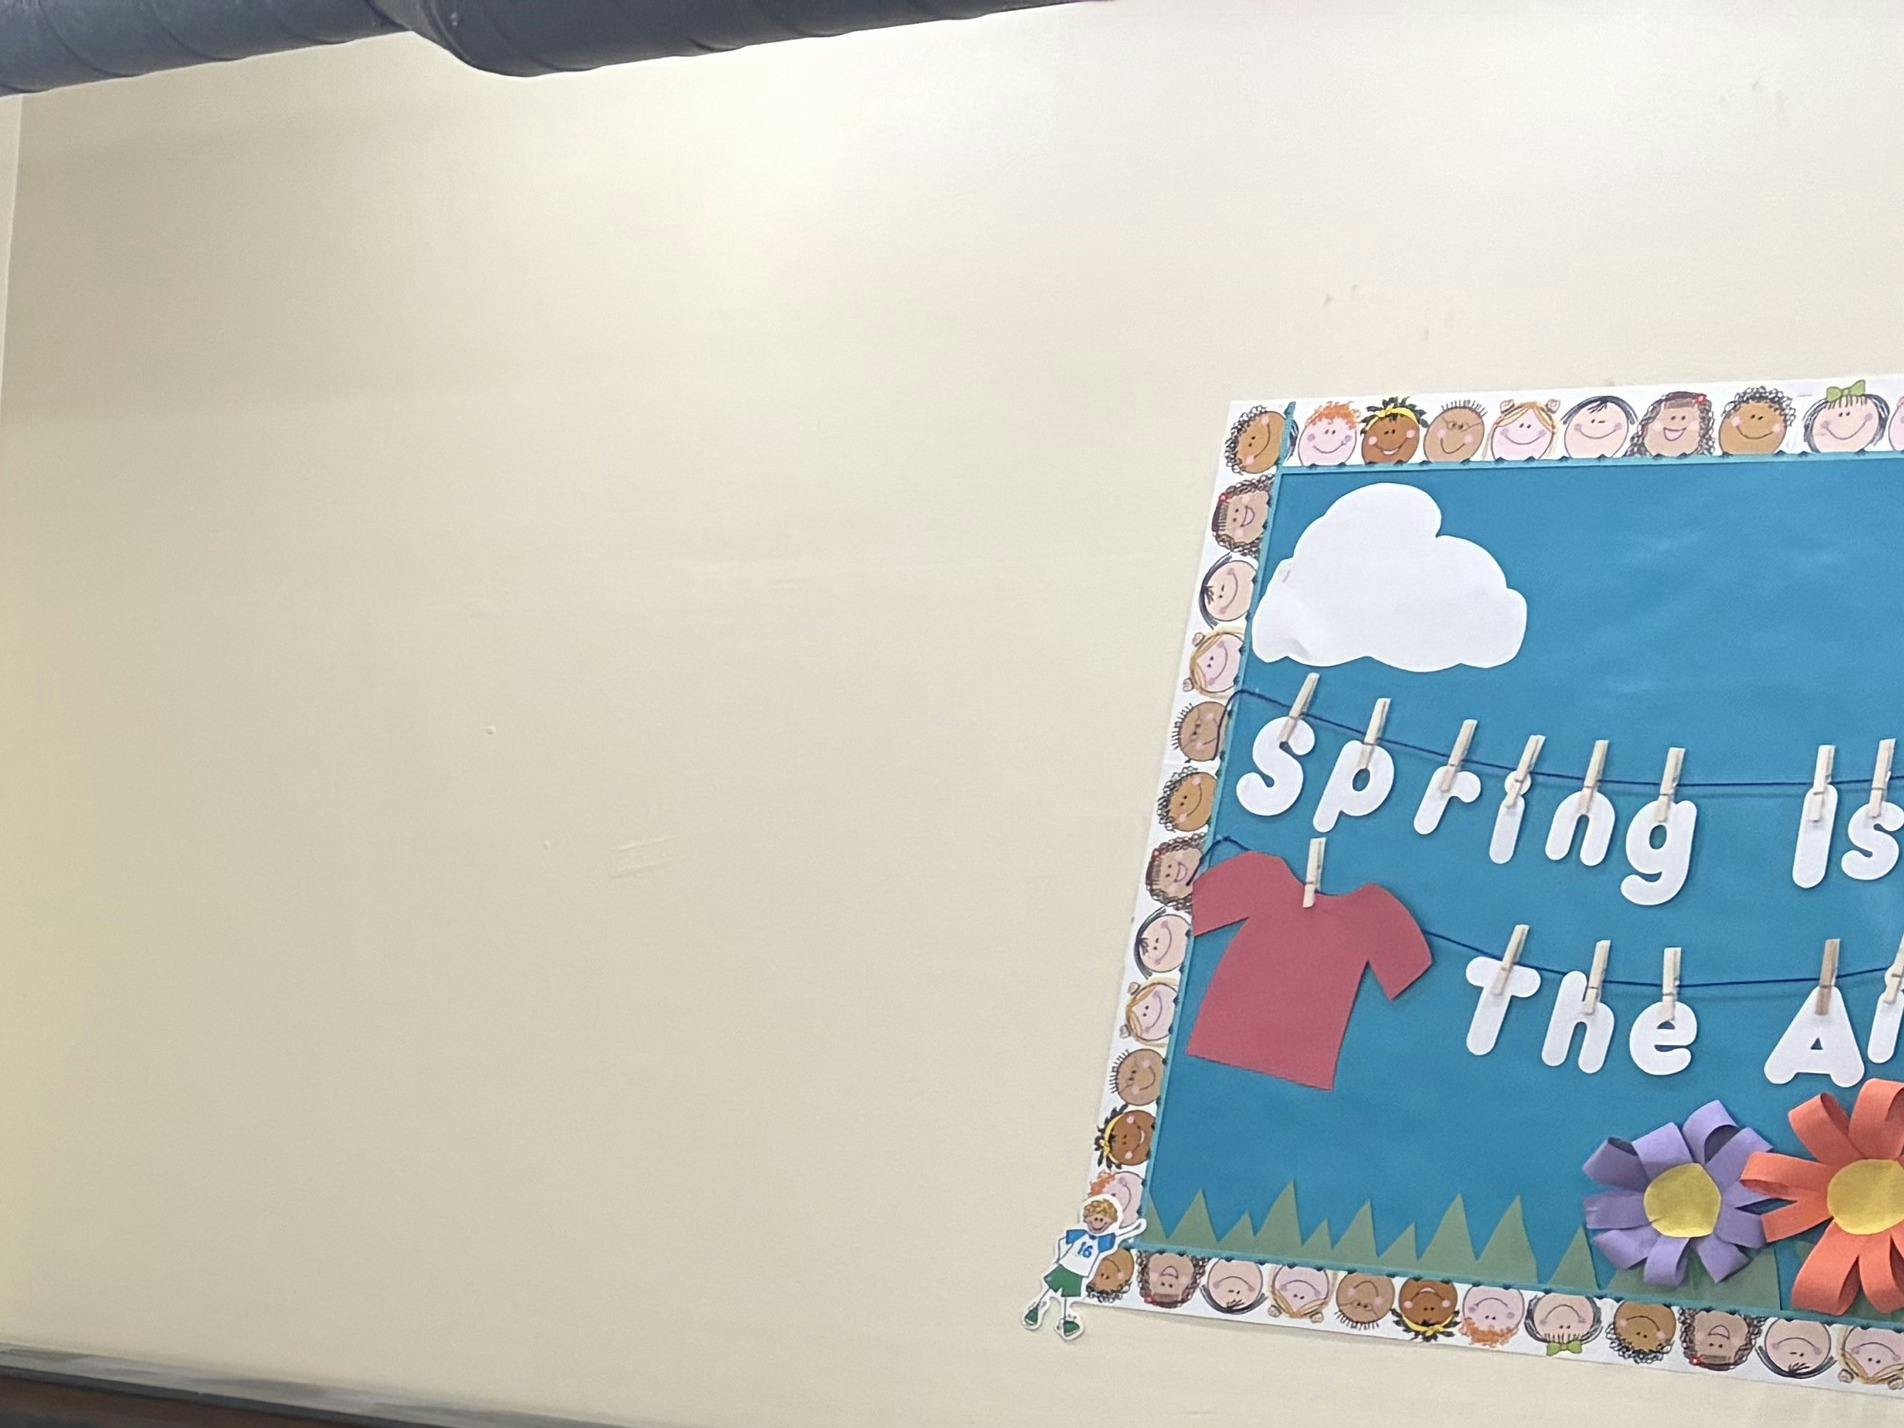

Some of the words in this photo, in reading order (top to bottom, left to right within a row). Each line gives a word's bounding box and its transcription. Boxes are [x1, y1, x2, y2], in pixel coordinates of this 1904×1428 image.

[1236, 715, 1697, 905] Spring
[1466, 955, 1697, 1076] The
[1078, 1242, 1093, 1257] 16
